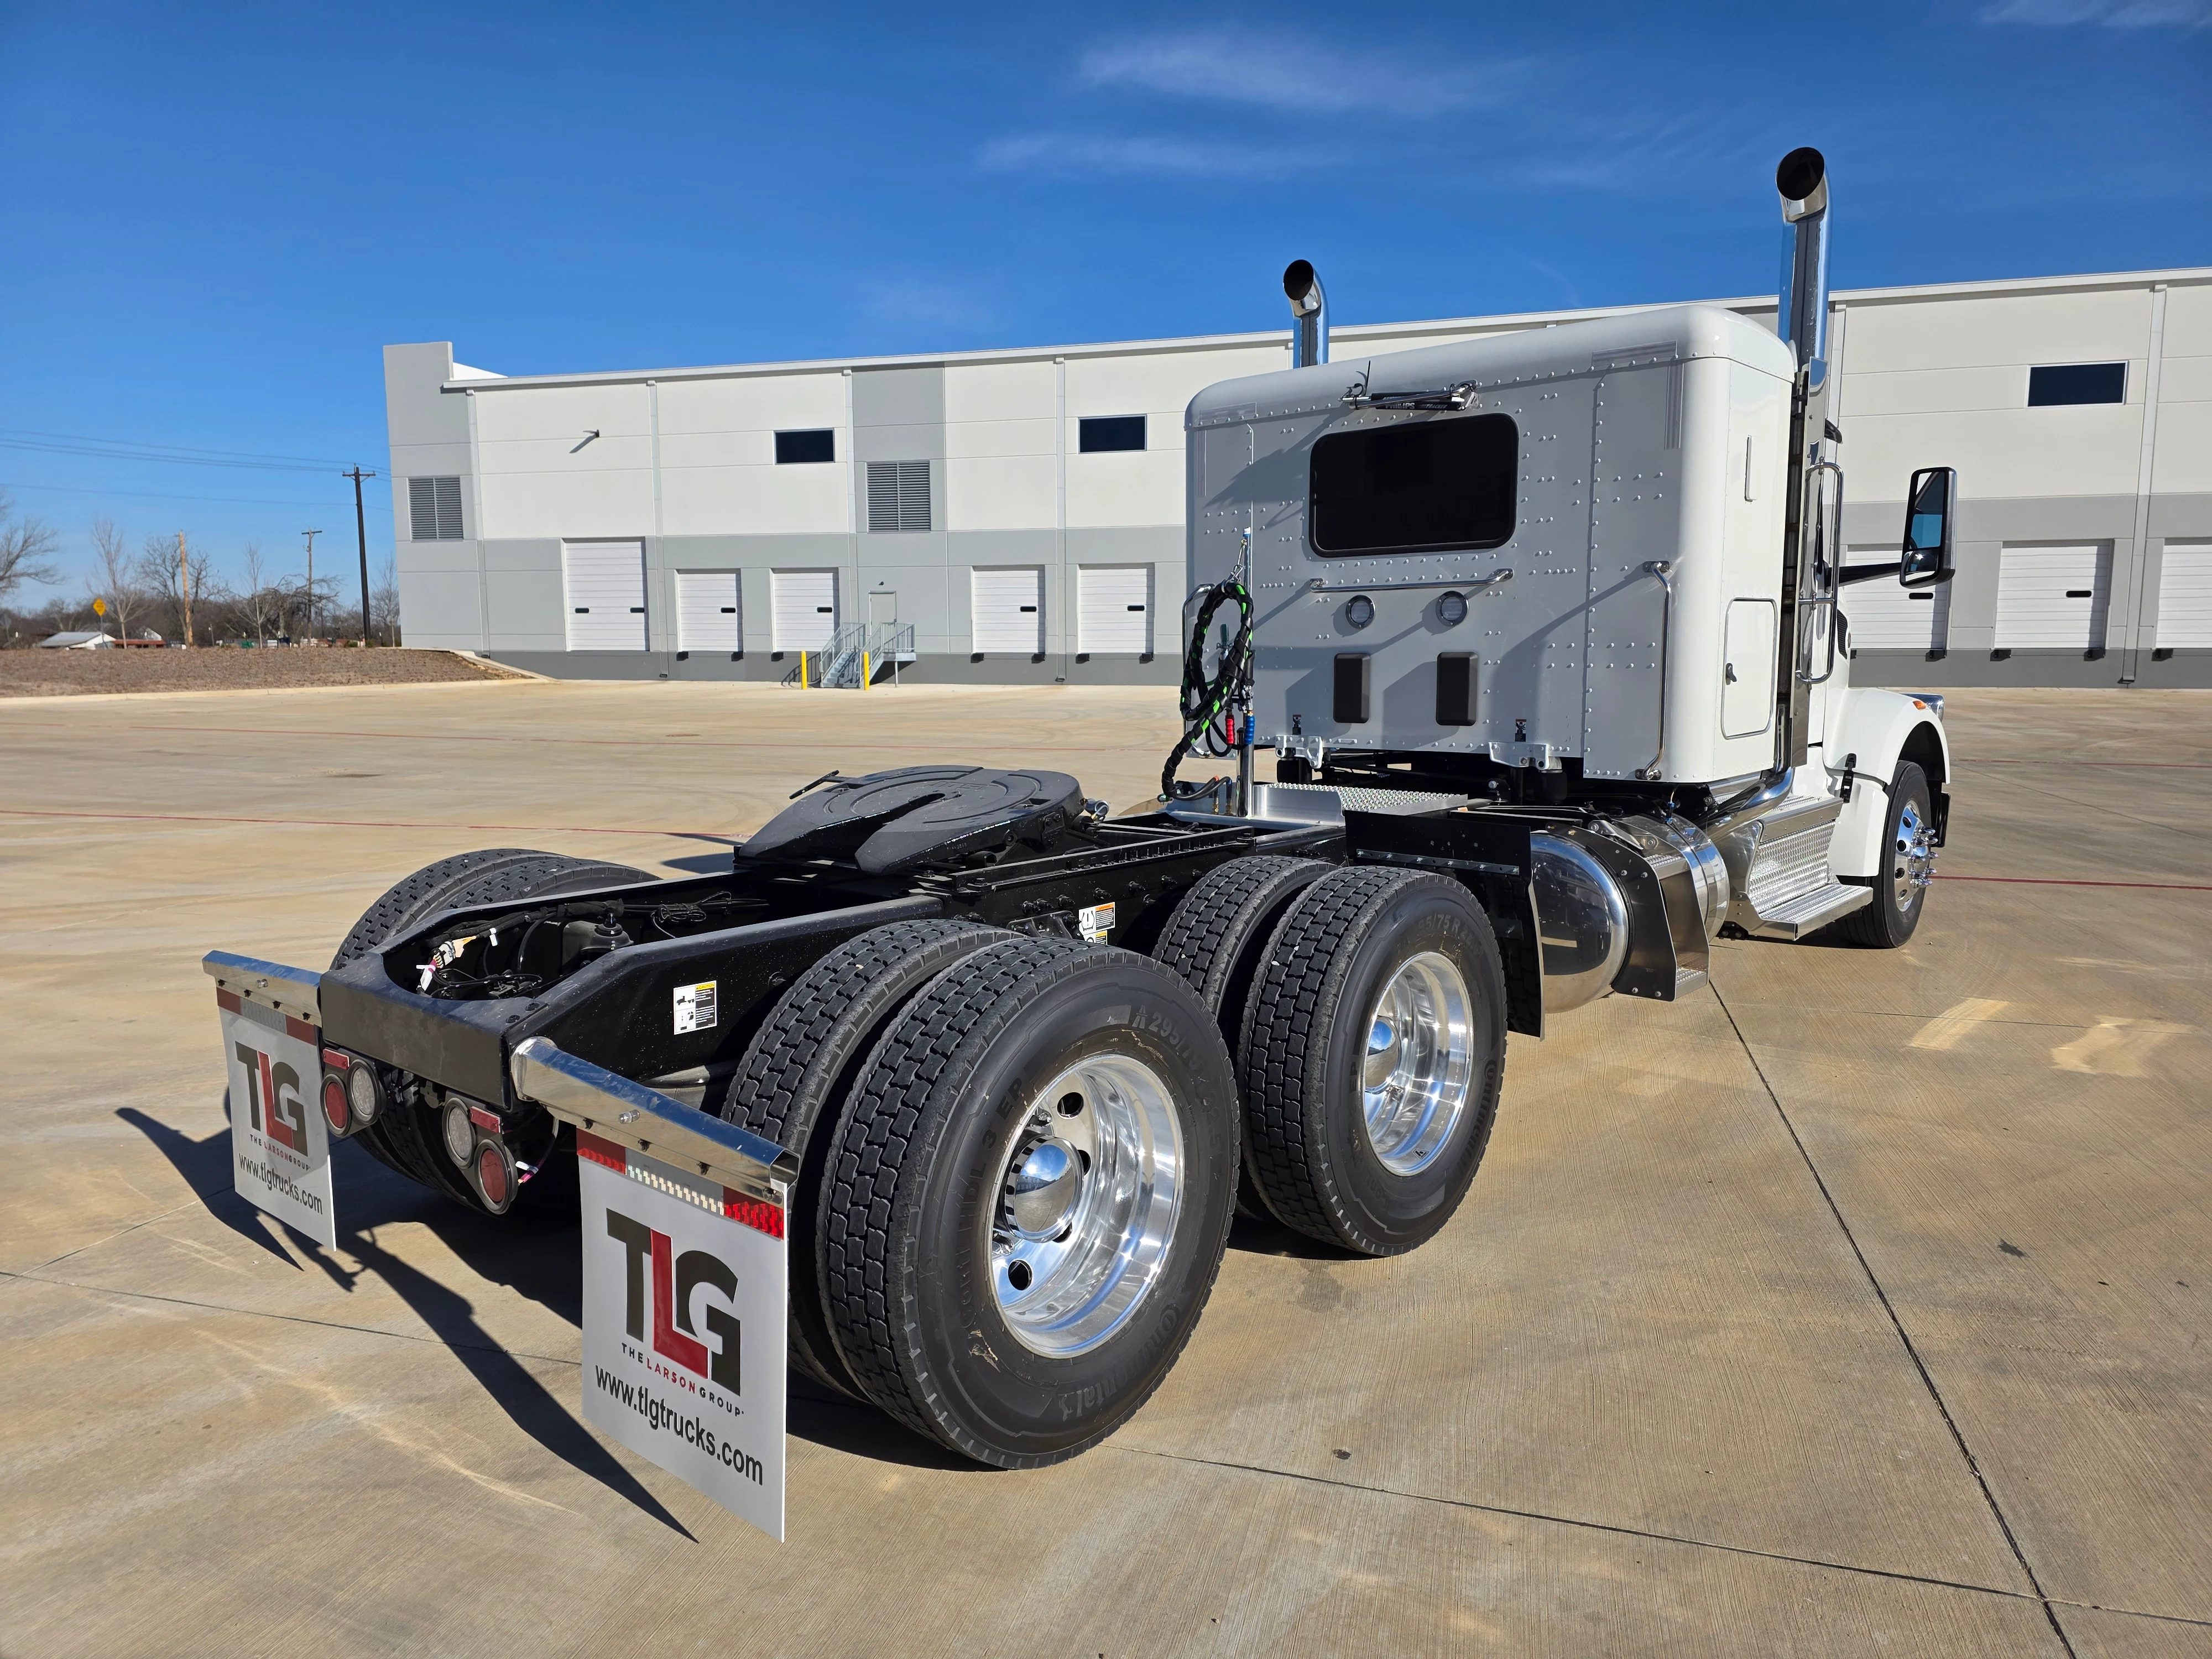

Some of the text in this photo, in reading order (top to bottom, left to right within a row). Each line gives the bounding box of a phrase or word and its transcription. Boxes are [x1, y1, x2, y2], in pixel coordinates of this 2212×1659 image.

[235, 1041, 308, 1157] TLG
[980, 1128, 997, 1151] 3
[994, 1077, 1023, 1122] EP
[239, 1153, 323, 1215] www.tlgtrucks.com
[250, 1134, 309, 1171] THE LARSON GROUP
[606, 1208, 741, 1397] TLG
[622, 1342, 740, 1416] THE LARSON GROUP
[596, 1365, 764, 1486] www.tlgtrucks.com
